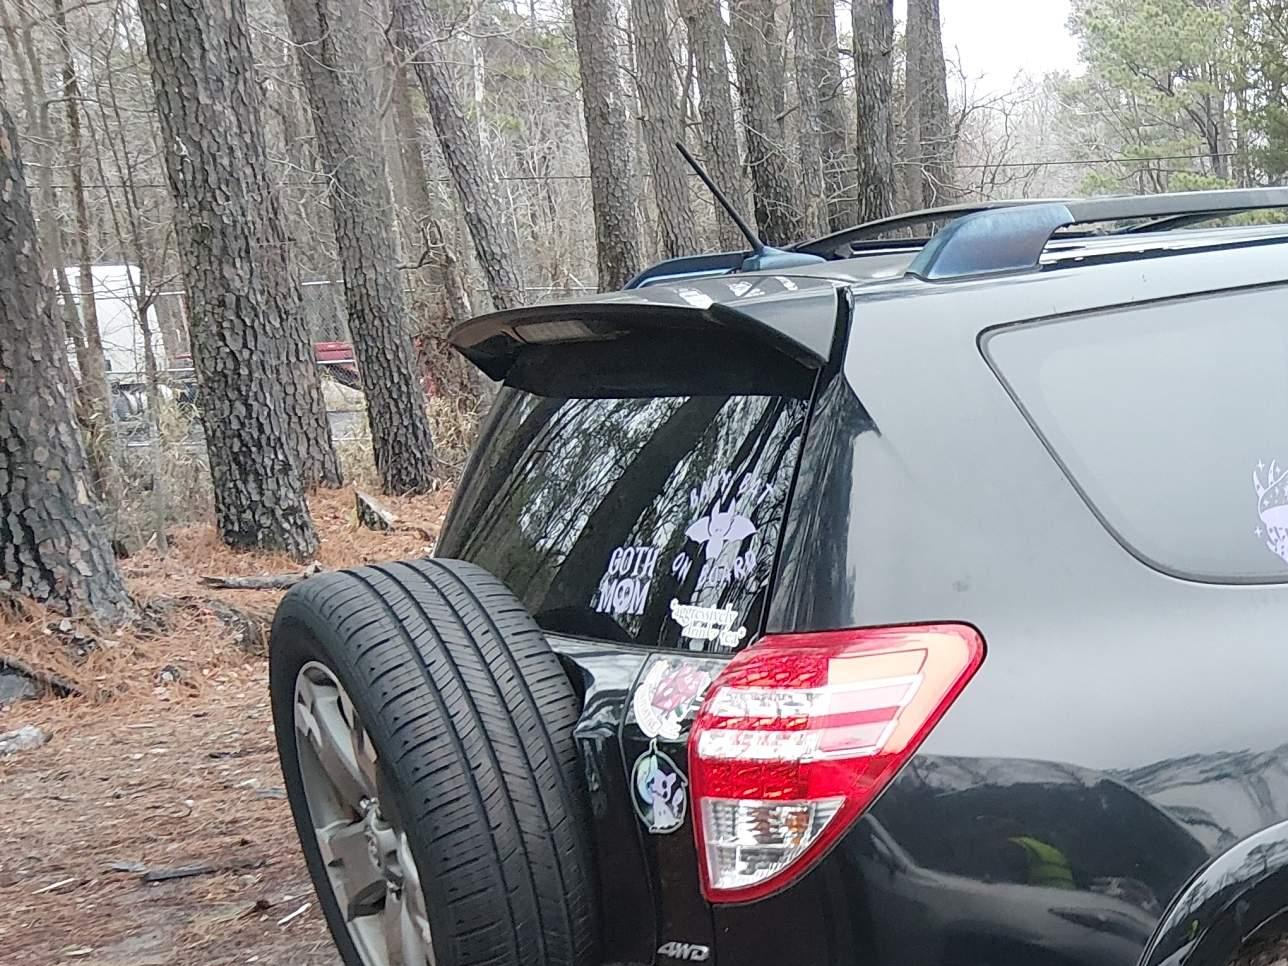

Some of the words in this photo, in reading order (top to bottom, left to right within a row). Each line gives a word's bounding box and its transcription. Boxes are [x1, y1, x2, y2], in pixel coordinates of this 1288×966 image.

[607, 546, 659, 577] GOTH
[671, 552, 693, 585] ON
[697, 551, 757, 586] BOARD
[596, 578, 651, 615] MOM
